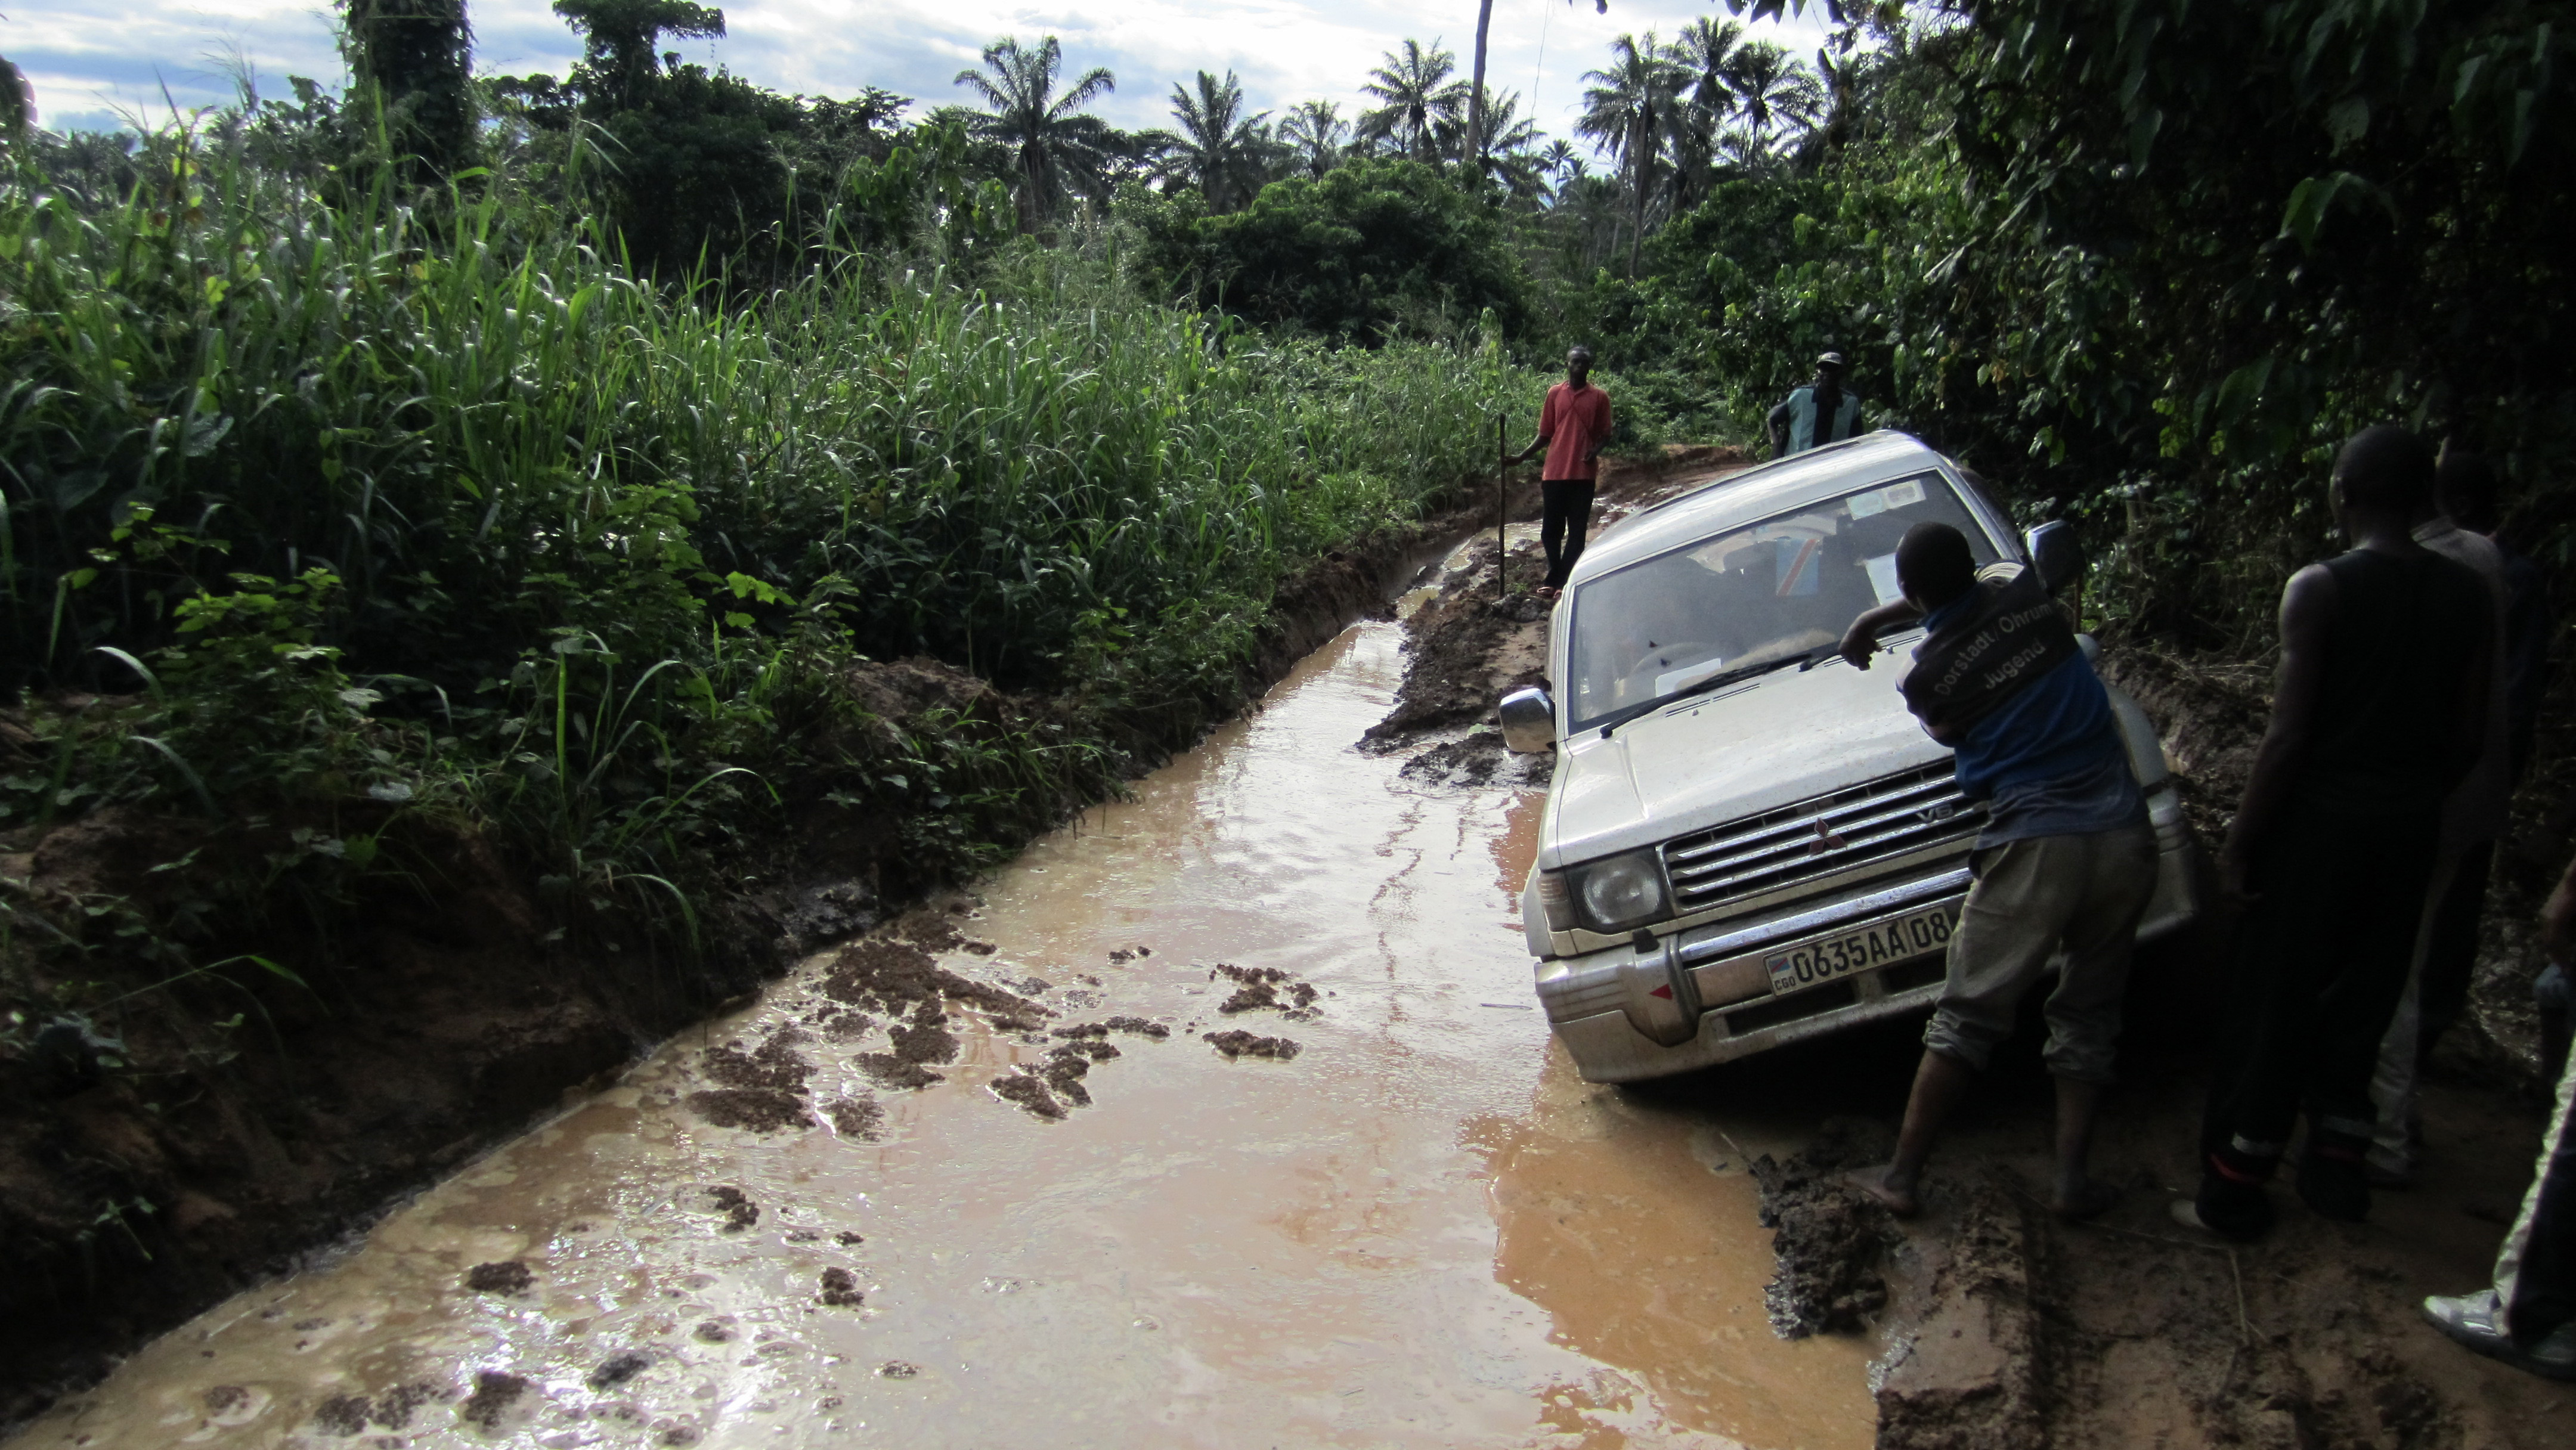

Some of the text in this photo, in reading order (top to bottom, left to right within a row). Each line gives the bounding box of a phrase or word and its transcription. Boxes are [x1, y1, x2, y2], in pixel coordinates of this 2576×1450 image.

[1984, 637, 2046, 690] Jugend
[1915, 803, 1954, 822] V6
[1791, 912, 1950, 983] 0635AA 08
[1773, 975, 1796, 991] CGO
